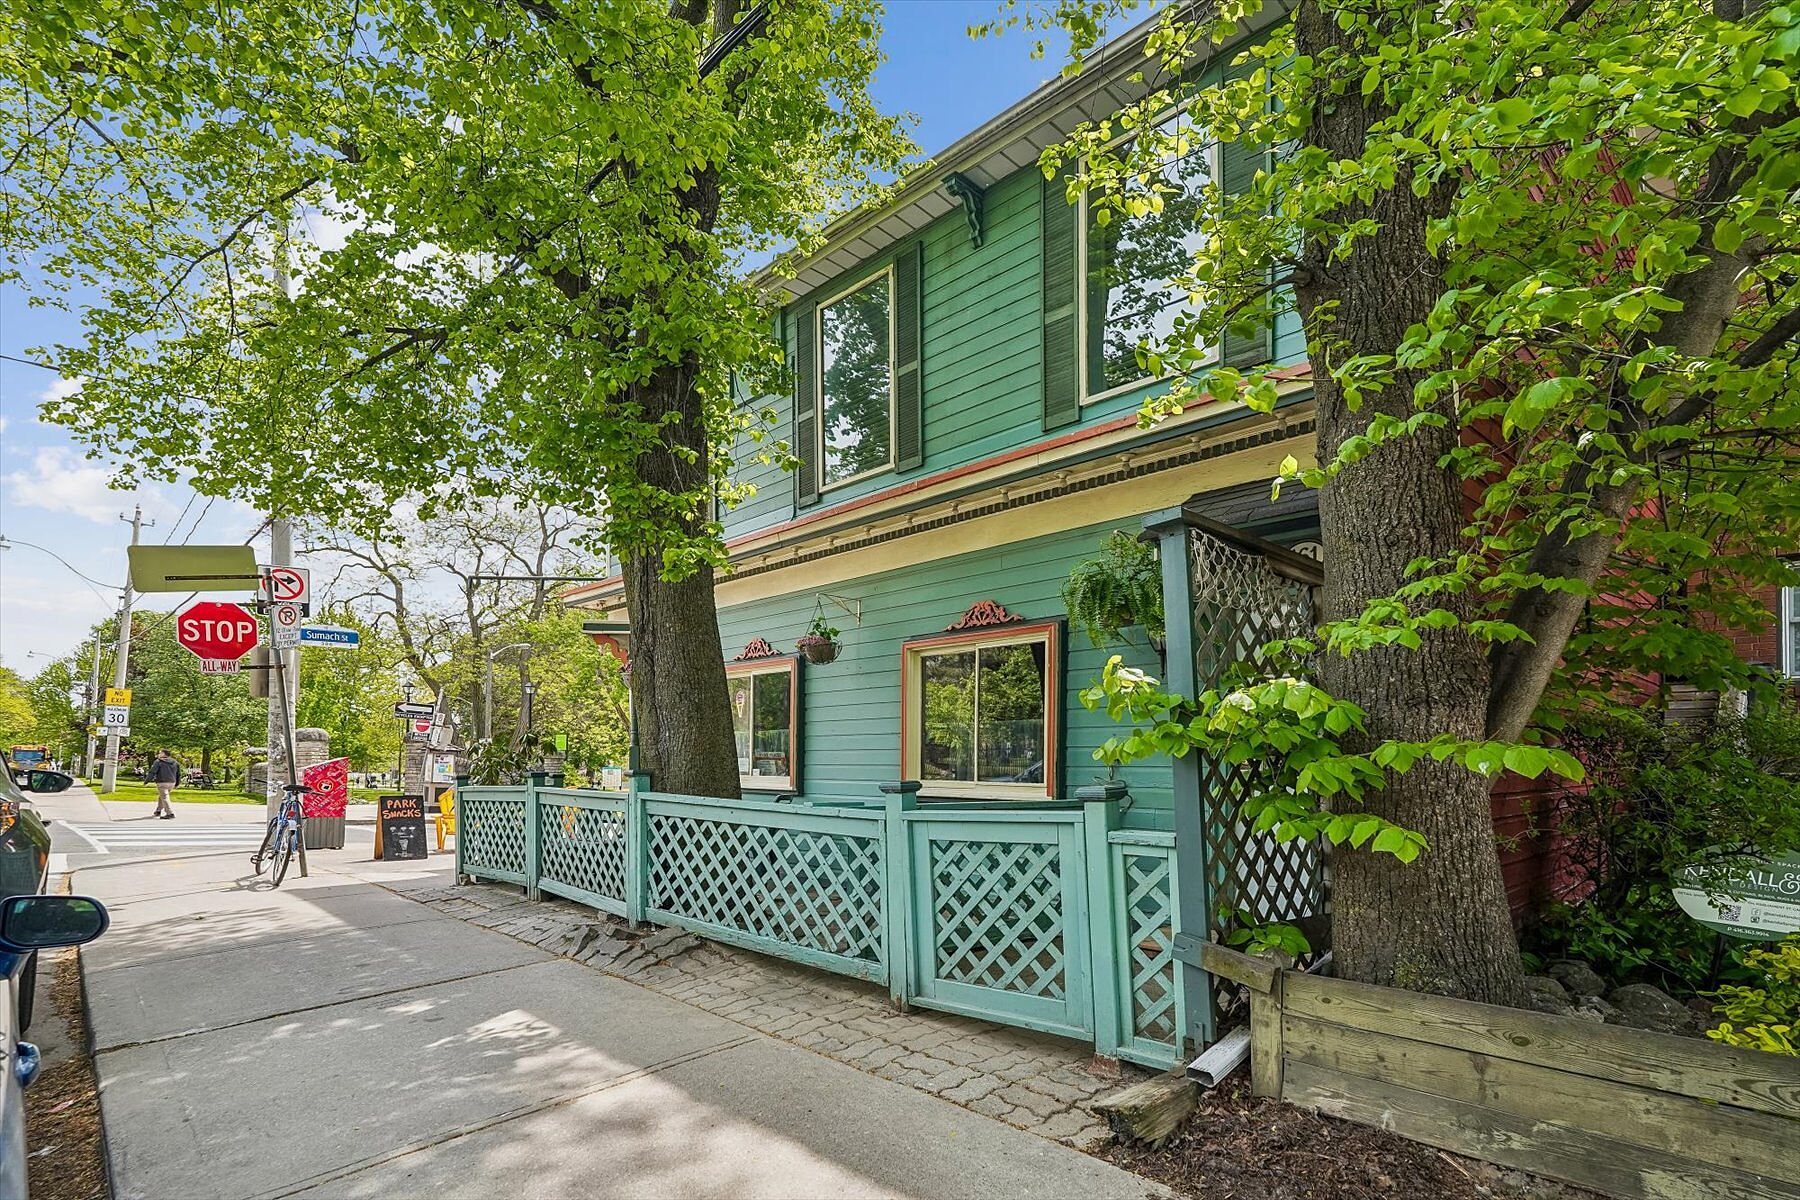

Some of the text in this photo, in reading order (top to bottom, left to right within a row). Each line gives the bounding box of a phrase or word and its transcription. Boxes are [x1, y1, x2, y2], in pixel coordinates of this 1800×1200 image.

[183, 619, 253, 642] STOP
[306, 631, 349, 642] Sumach St
[202, 660, 238, 672] ALL-WAY
[108, 713, 125, 724] 30
[386, 799, 417, 809] PARK
[382, 809, 422, 820] SNACKS
